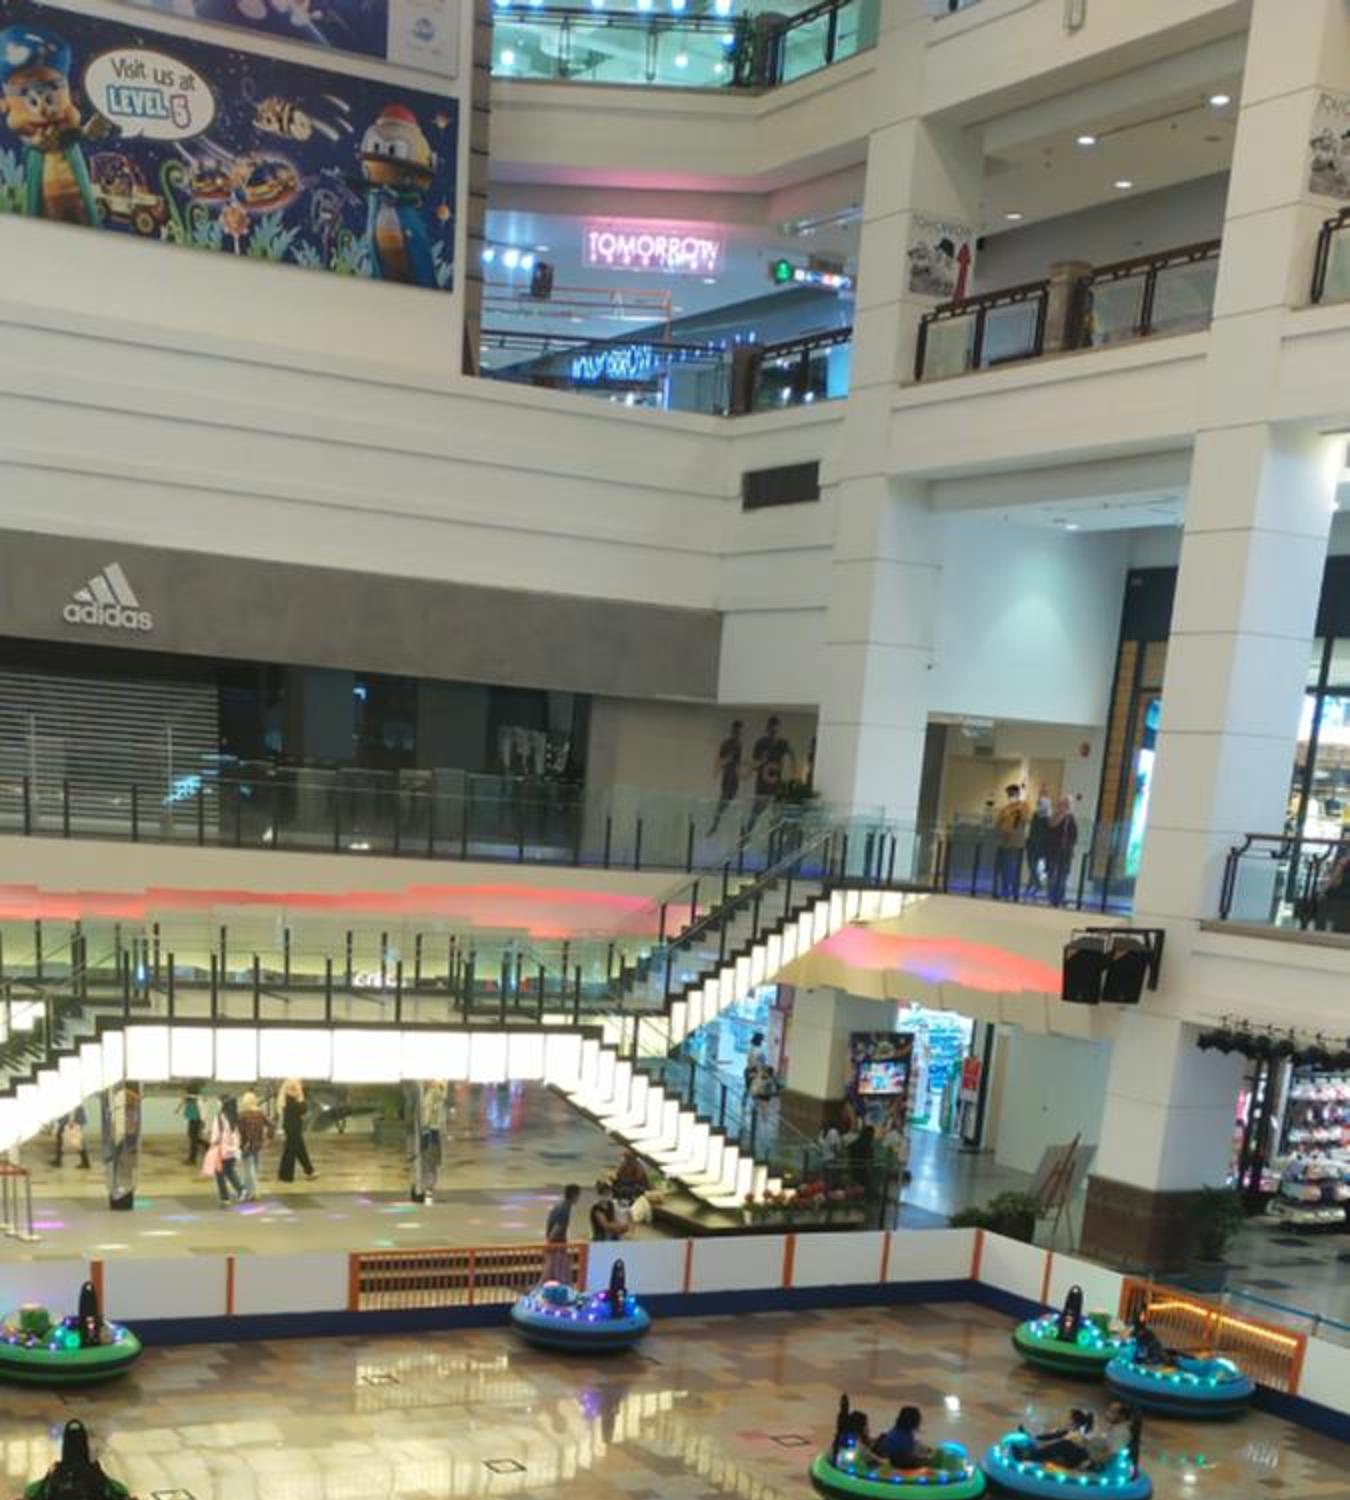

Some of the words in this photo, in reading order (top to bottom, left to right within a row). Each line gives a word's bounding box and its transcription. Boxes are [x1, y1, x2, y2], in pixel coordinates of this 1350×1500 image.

[109, 58, 147, 80] Visit
[153, 67, 175, 87] us
[179, 73, 197, 91] at
[106, 84, 169, 119] LEVEL
[588, 231, 720, 261] TOMORROW
[63, 601, 154, 631] adidas
